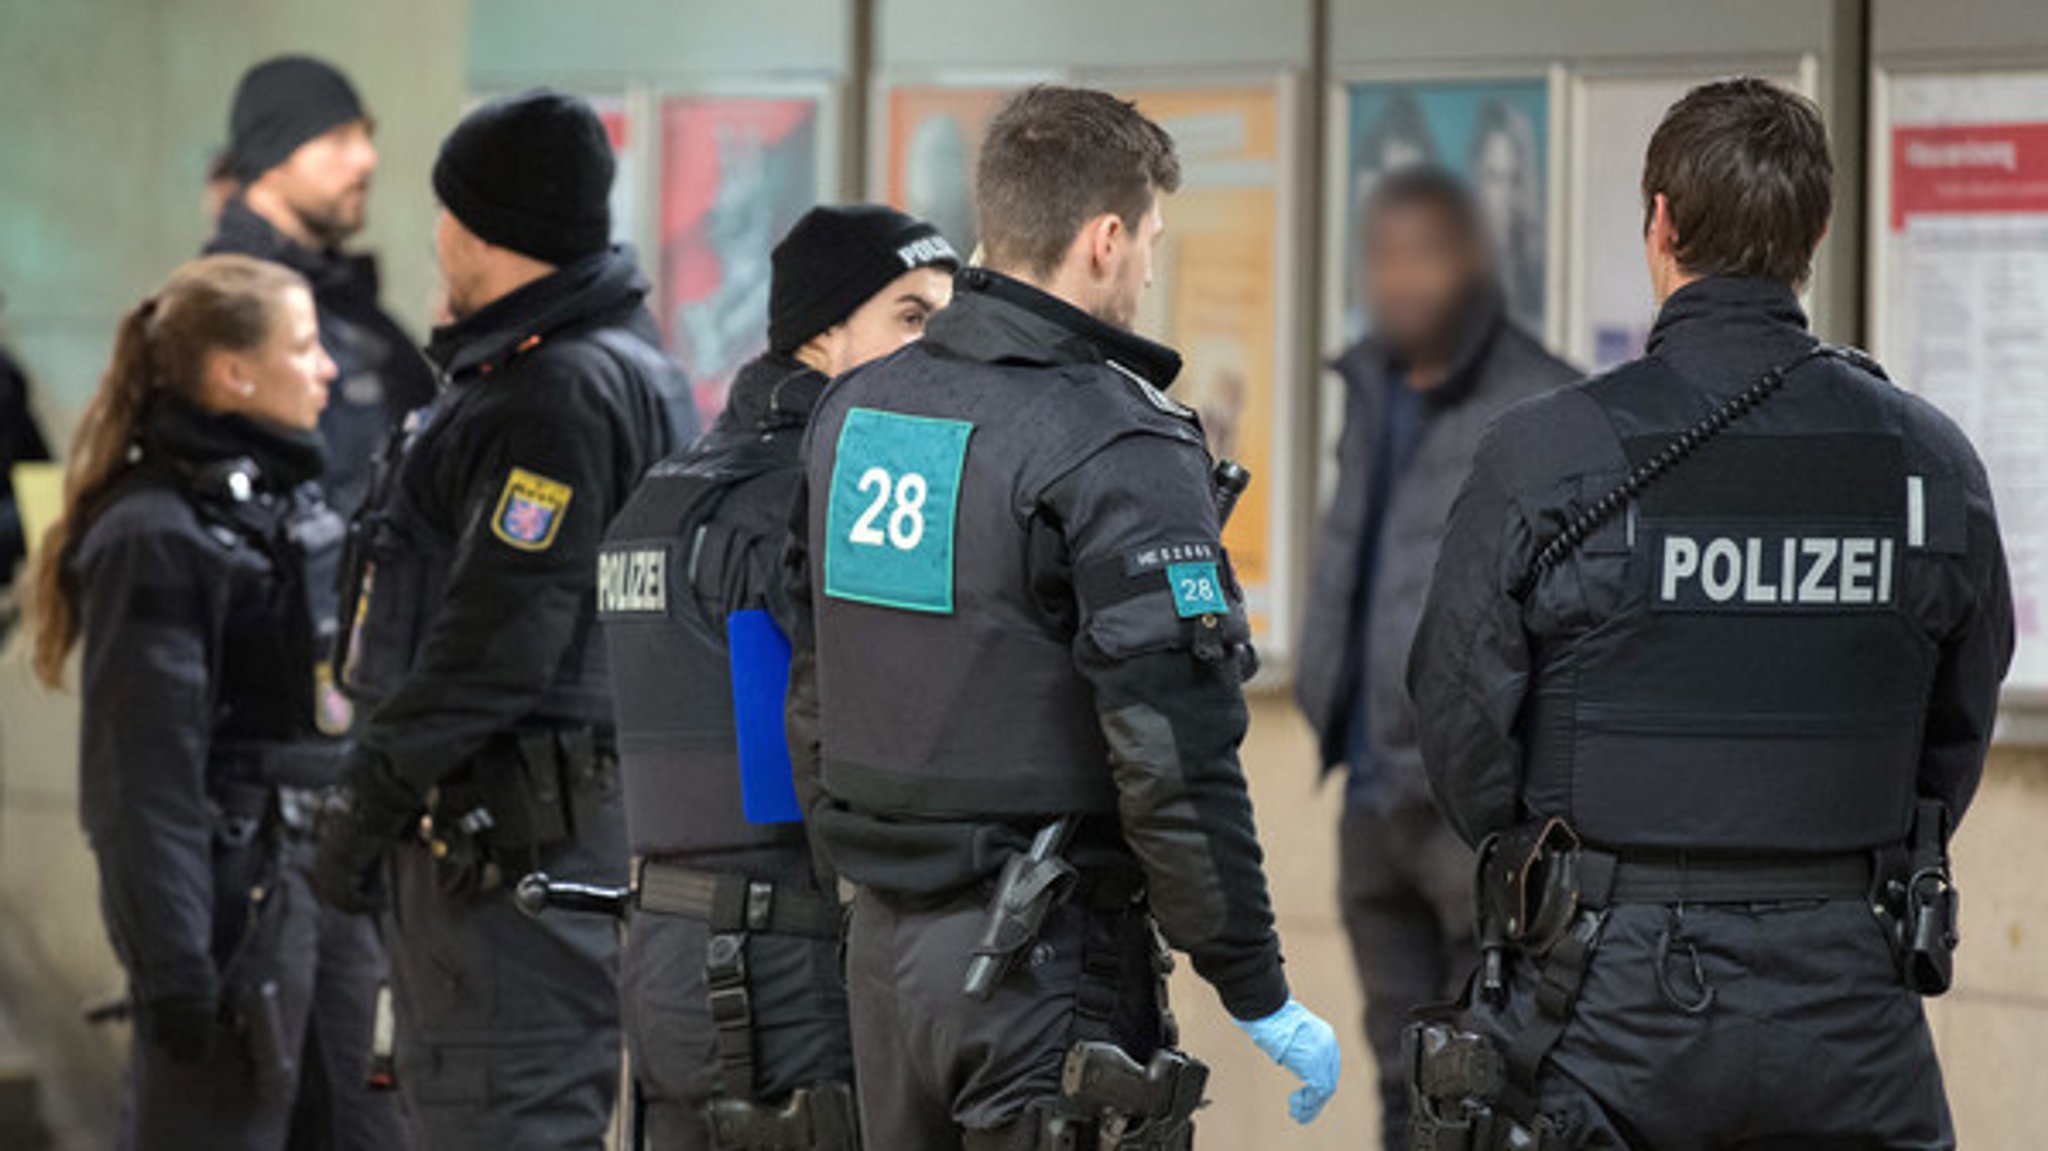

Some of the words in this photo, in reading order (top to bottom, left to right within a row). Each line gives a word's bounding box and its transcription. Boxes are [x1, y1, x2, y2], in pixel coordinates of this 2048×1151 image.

[897, 236, 957, 268] POLI
[849, 466, 927, 550] 28
[597, 550, 667, 612] POLIZEI
[1181, 577, 1214, 602] 28
[1660, 536, 1894, 603] POLIZEI
